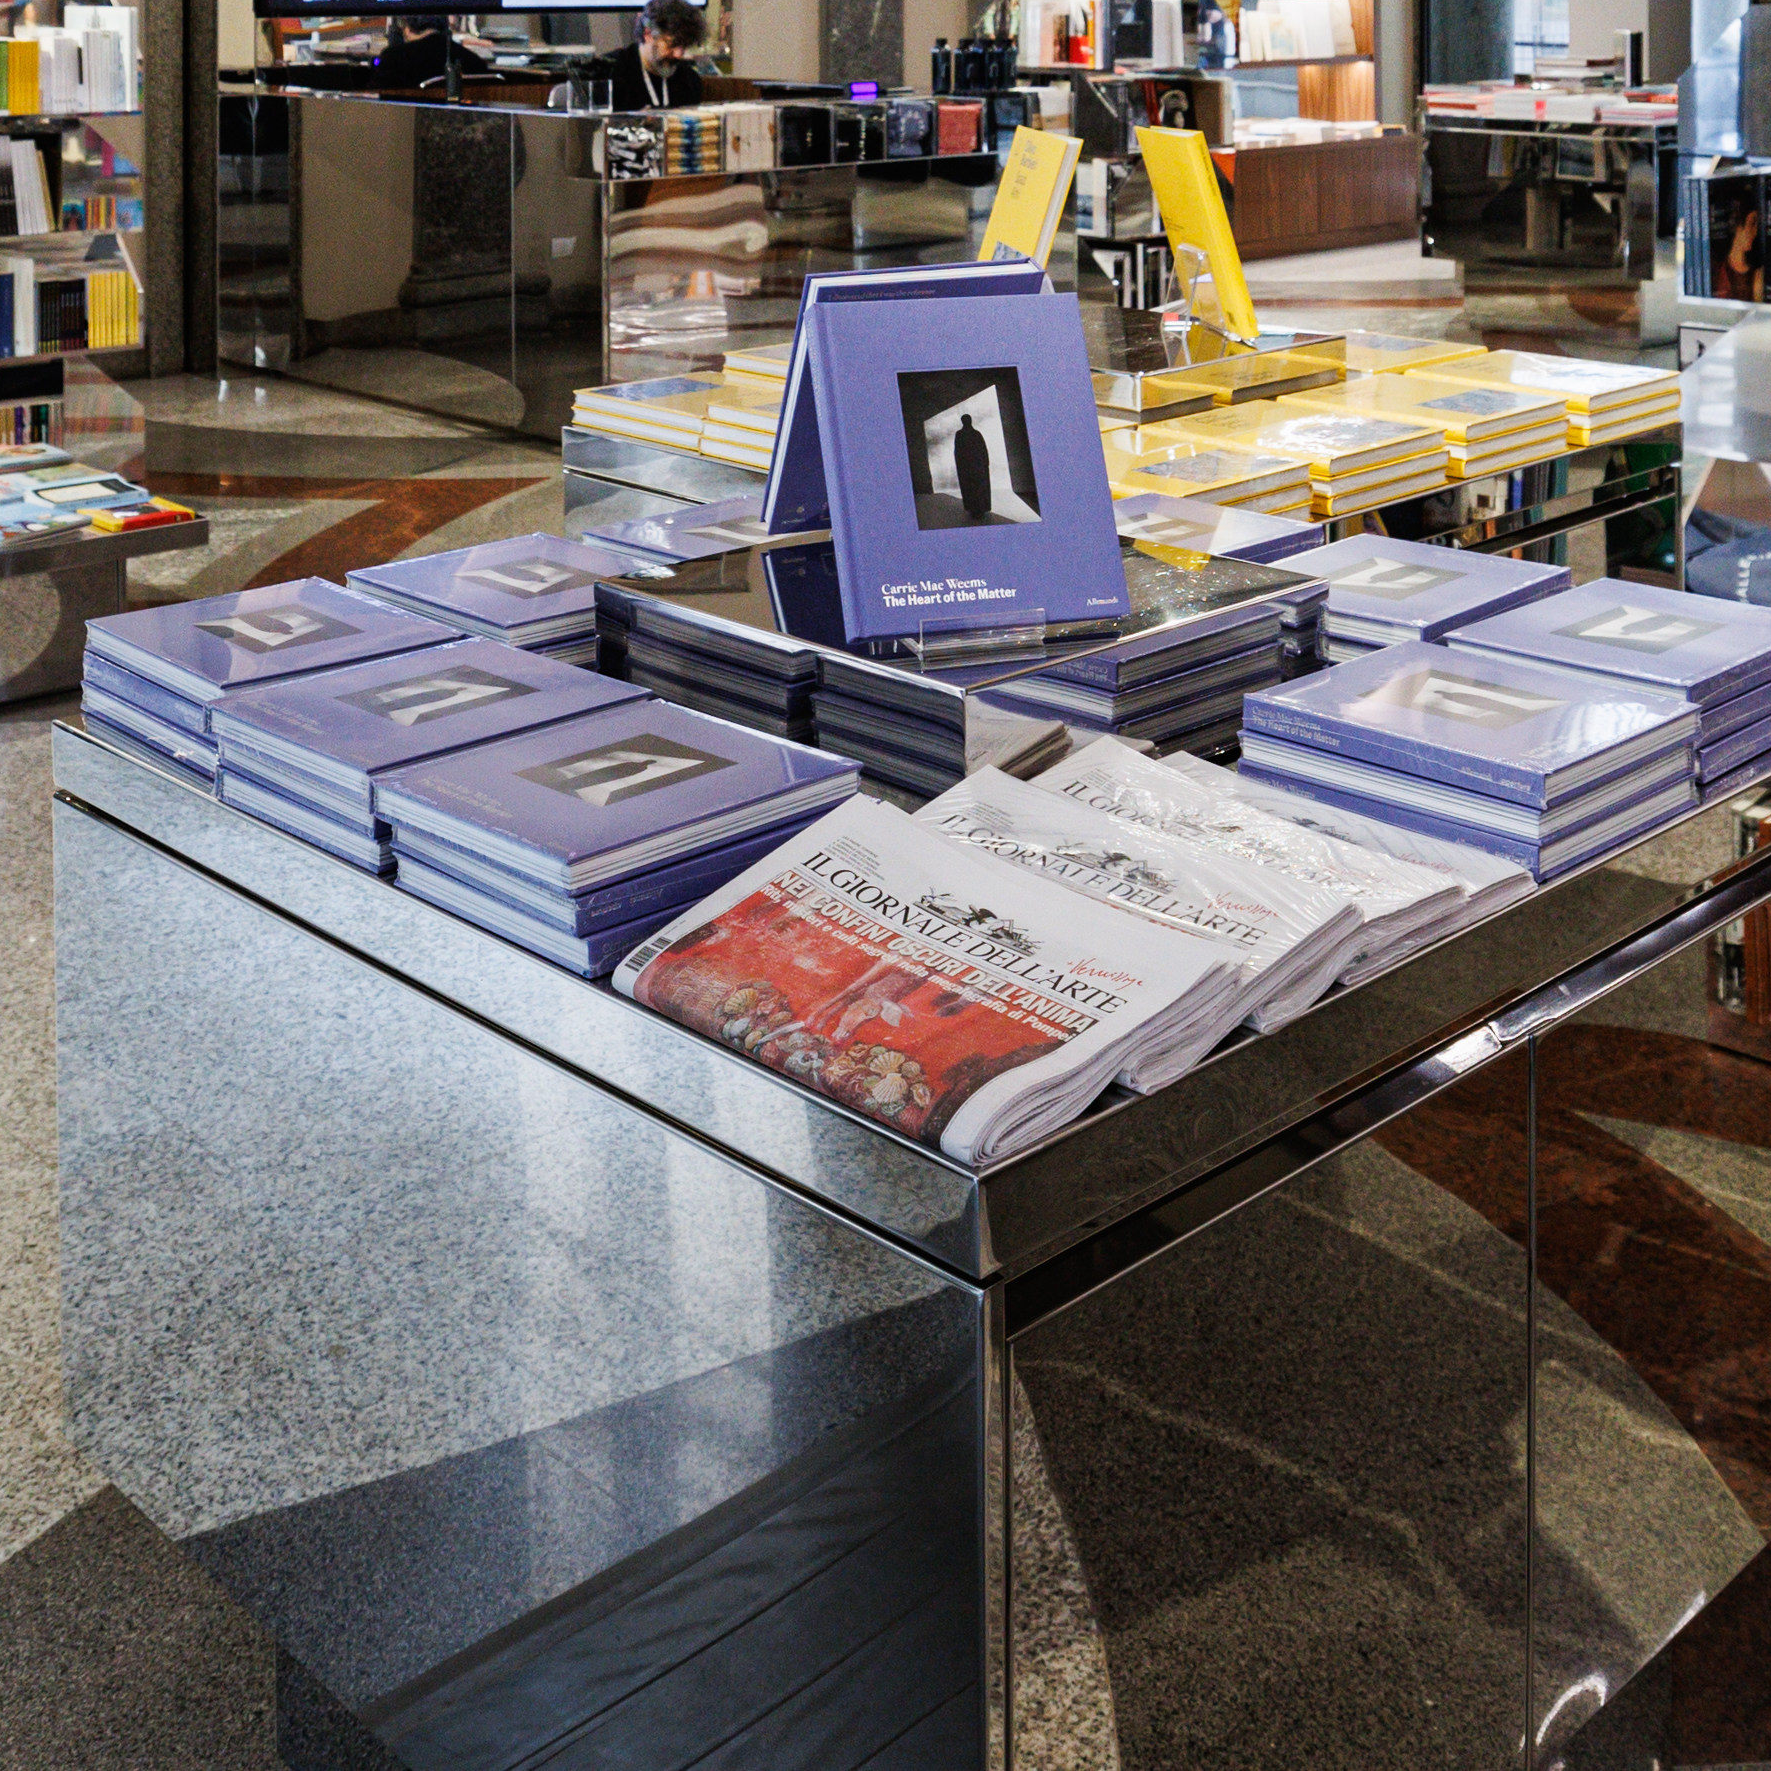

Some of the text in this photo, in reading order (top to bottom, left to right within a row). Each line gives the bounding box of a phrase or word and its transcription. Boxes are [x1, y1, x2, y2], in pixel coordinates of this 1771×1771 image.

[881, 578, 987, 595] Carrie Mae Weems
[883, 587, 1017, 608] The Heart of the Matter
[1253, 716, 1340, 746] The Heart of the Matter
[1060, 780, 1090, 805] IL
[939, 813, 1269, 948] IL GIORNALE DELL'ARTE
[760, 883, 1078, 1044] Riti, misteri e culti segreti nella megalografia di Pompei
[774, 873, 1096, 1034] NEI CONFINI OSCURI DELL'ANIMA
[801, 851, 1128, 1014] IL GIORNALE DELL'ARTE
